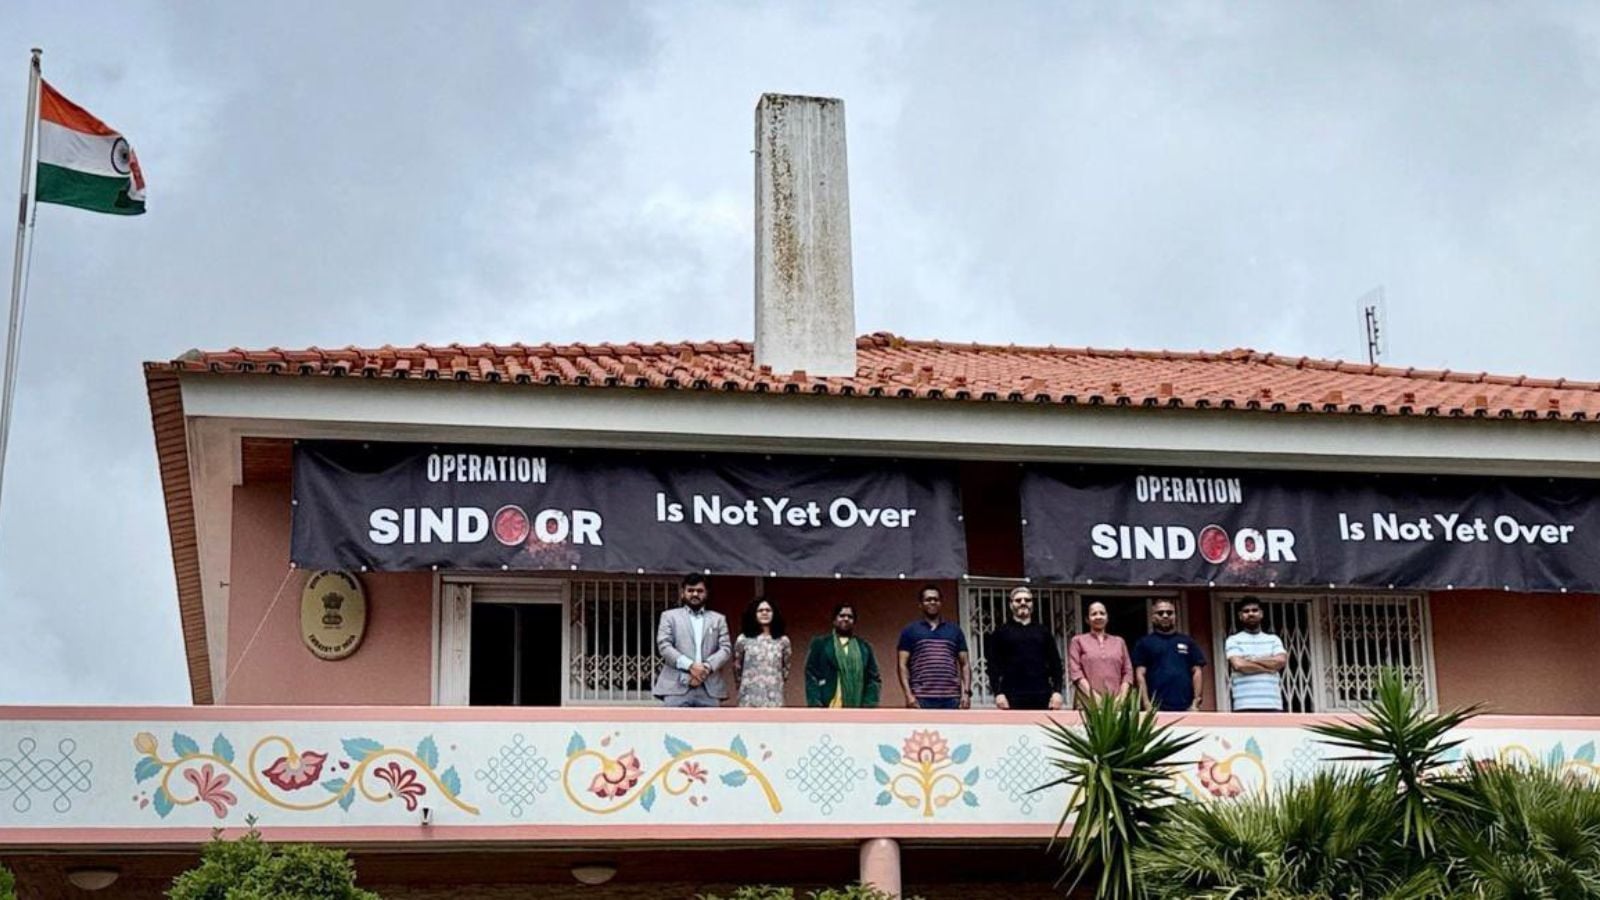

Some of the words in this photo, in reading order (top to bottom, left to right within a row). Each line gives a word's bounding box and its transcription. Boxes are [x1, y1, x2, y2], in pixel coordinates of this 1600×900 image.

[427, 454, 547, 483] OPERATION
[1136, 475, 1243, 504] OPERATION
[656, 492, 684, 522] Is
[693, 495, 759, 526] Not
[763, 497, 821, 527] Yet
[829, 497, 917, 528] Over
[1338, 513, 1366, 541] Is
[1373, 512, 1432, 541] Not
[1432, 513, 1489, 542] Yet
[1494, 515, 1575, 544] Over
